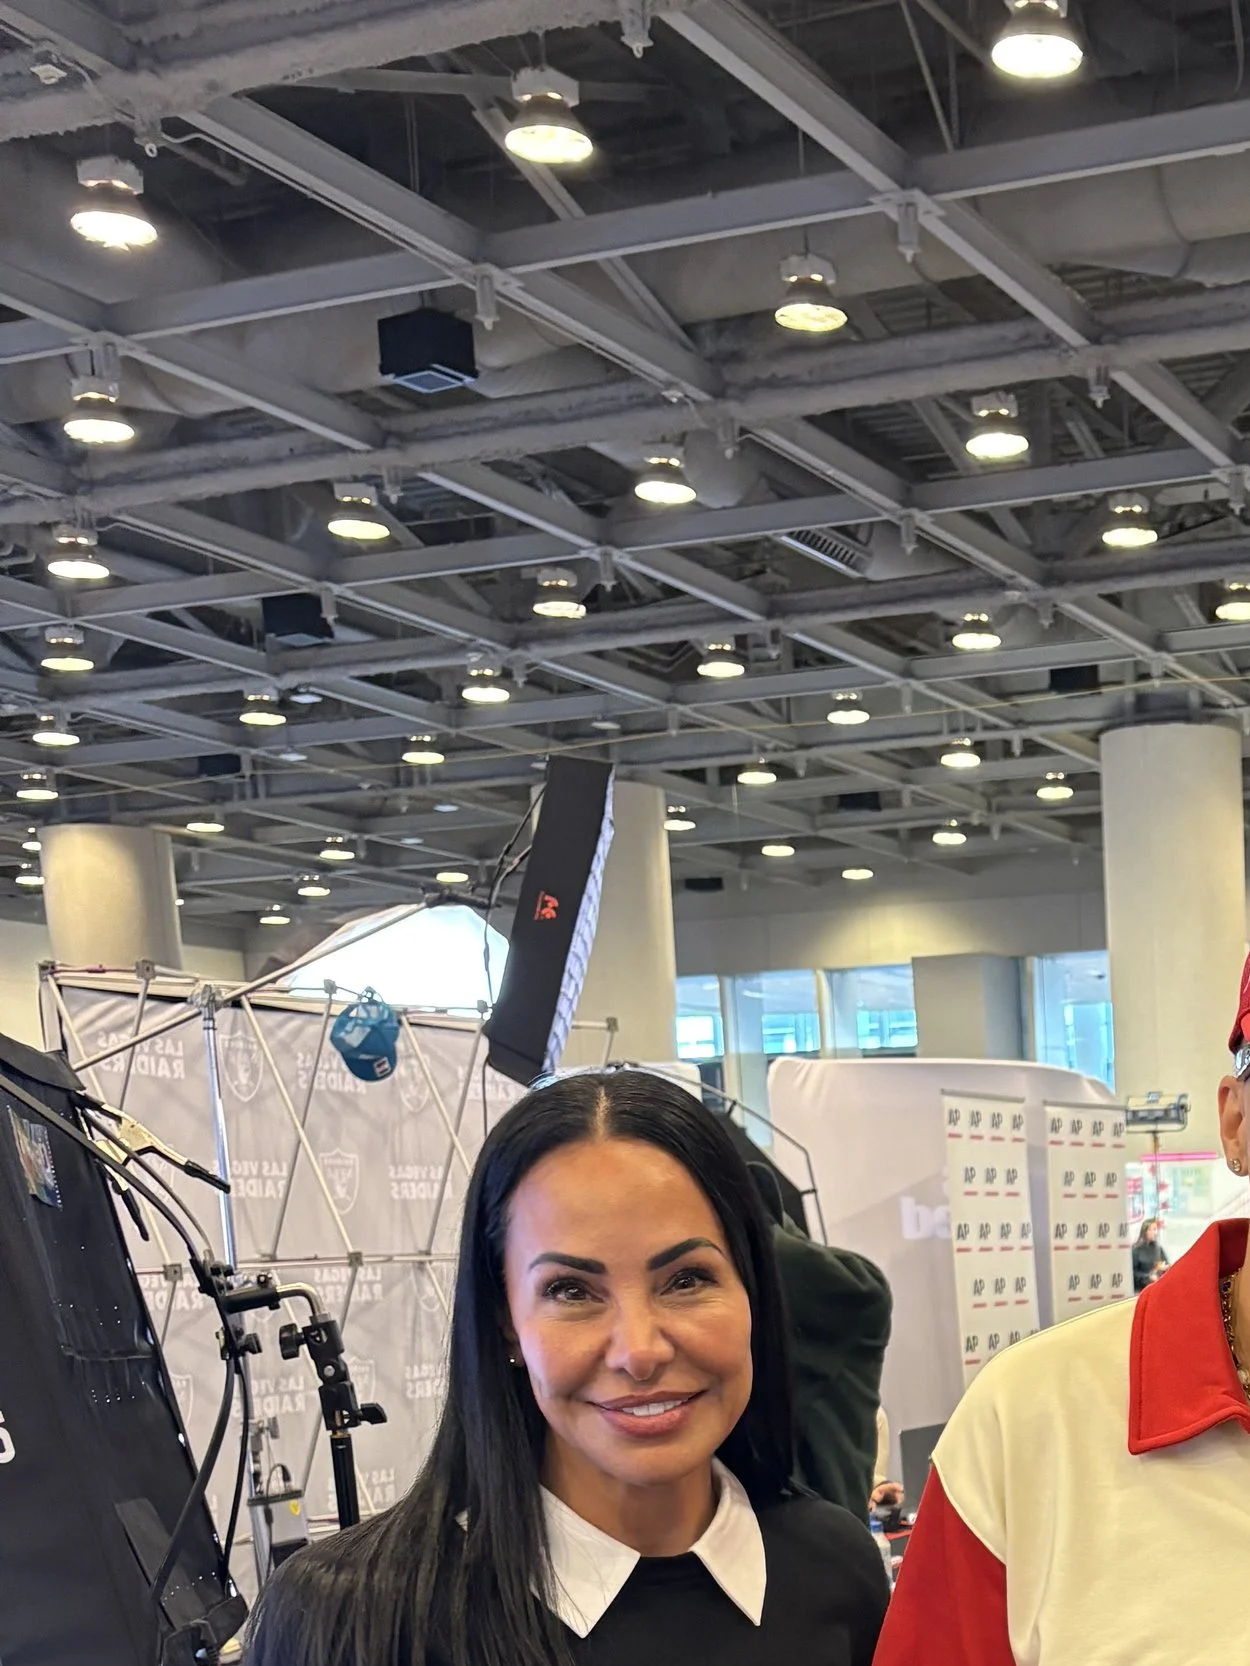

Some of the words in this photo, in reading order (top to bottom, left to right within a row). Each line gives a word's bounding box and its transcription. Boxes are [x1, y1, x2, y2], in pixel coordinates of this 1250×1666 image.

[948, 1109, 960, 1126] AP
[970, 1110, 982, 1128] AP
[991, 1112, 1003, 1129] AP
[1012, 1114, 1024, 1131] AP
[1050, 1117, 1063, 1133] AP
[1071, 1119, 1083, 1135] AP
[1092, 1120, 1104, 1137] AP
[1113, 1122, 1125, 1138] AP
[964, 1166, 976, 1184] AP
[985, 1167, 997, 1184] AP
[1006, 1168, 1018, 1185] AP
[1064, 1171, 1075, 1187] AP
[1084, 1171, 1096, 1187] AP
[1106, 1172, 1117, 1187] AP
[957, 1223, 970, 1240] AP
[979, 1222, 991, 1240] AP
[1000, 1222, 1012, 1239] AP
[1021, 1222, 1032, 1239] AP
[1055, 1223, 1067, 1239] AP
[1076, 1223, 1088, 1239] AP
[1098, 1222, 1110, 1238] AP
[973, 1278, 985, 1296] AP
[994, 1277, 1006, 1295] AP
[1015, 1277, 1027, 1293] AP
[1068, 1274, 1080, 1290] AP
[1090, 1274, 1102, 1290] AP
[1111, 1273, 1123, 1288] AP
[965, 1335, 979, 1352] AP
[988, 1333, 1000, 1350] AP
